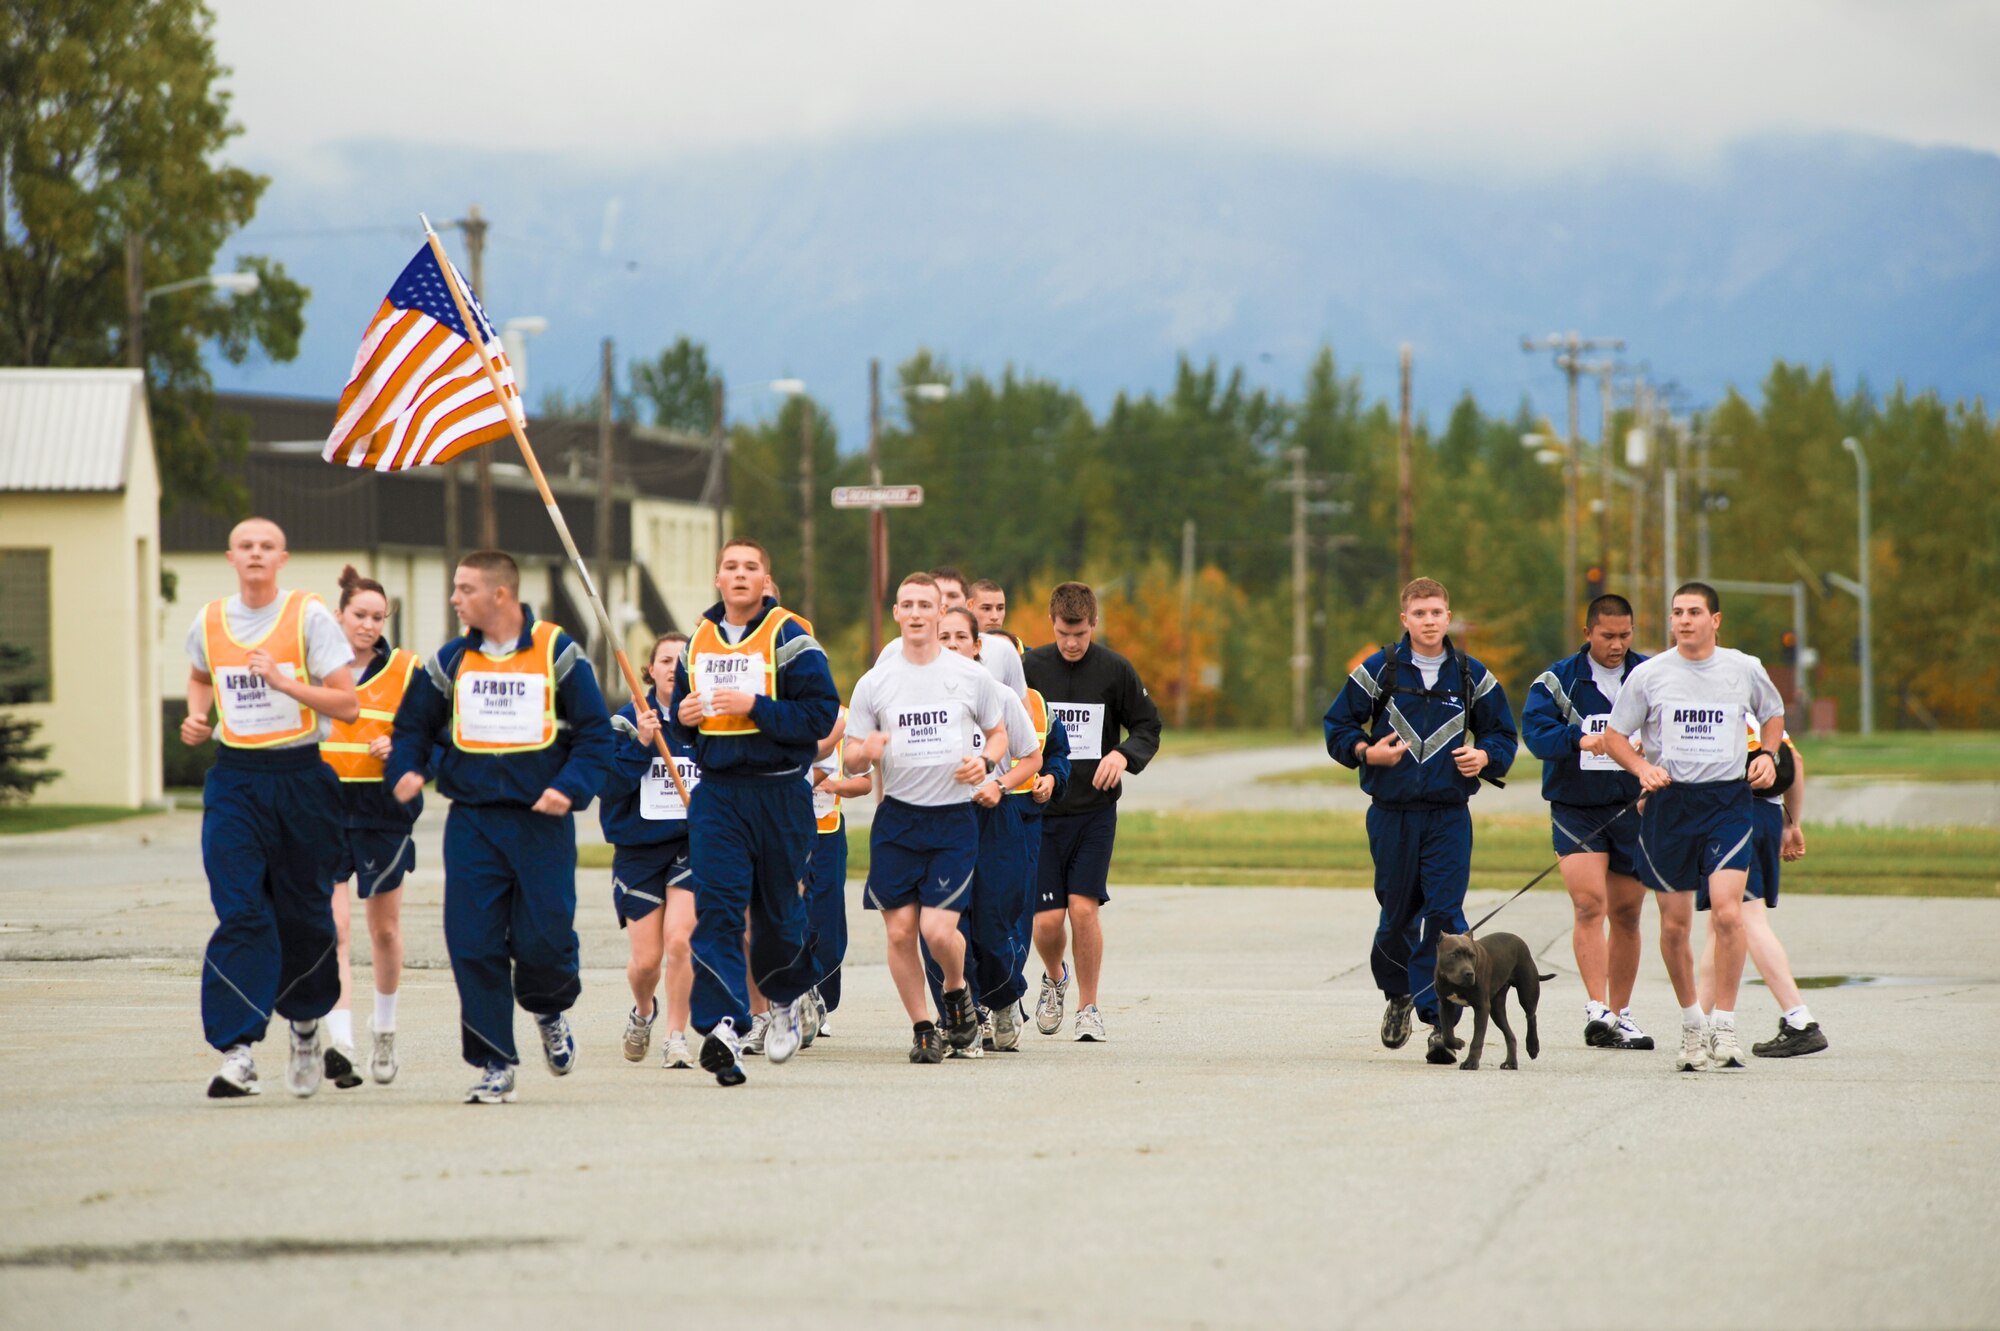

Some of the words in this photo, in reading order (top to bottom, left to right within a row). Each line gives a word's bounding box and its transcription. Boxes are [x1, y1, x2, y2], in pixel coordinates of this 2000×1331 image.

[705, 658, 749, 673] AFROTC
[472, 680, 526, 696] AFROTC
[898, 710, 948, 727] AFROTC
[1673, 709, 1724, 723] AFROTC
[911, 727, 937, 737] Det001
[1684, 725, 1712, 733] Det001
[652, 764, 702, 778] AFOTC
